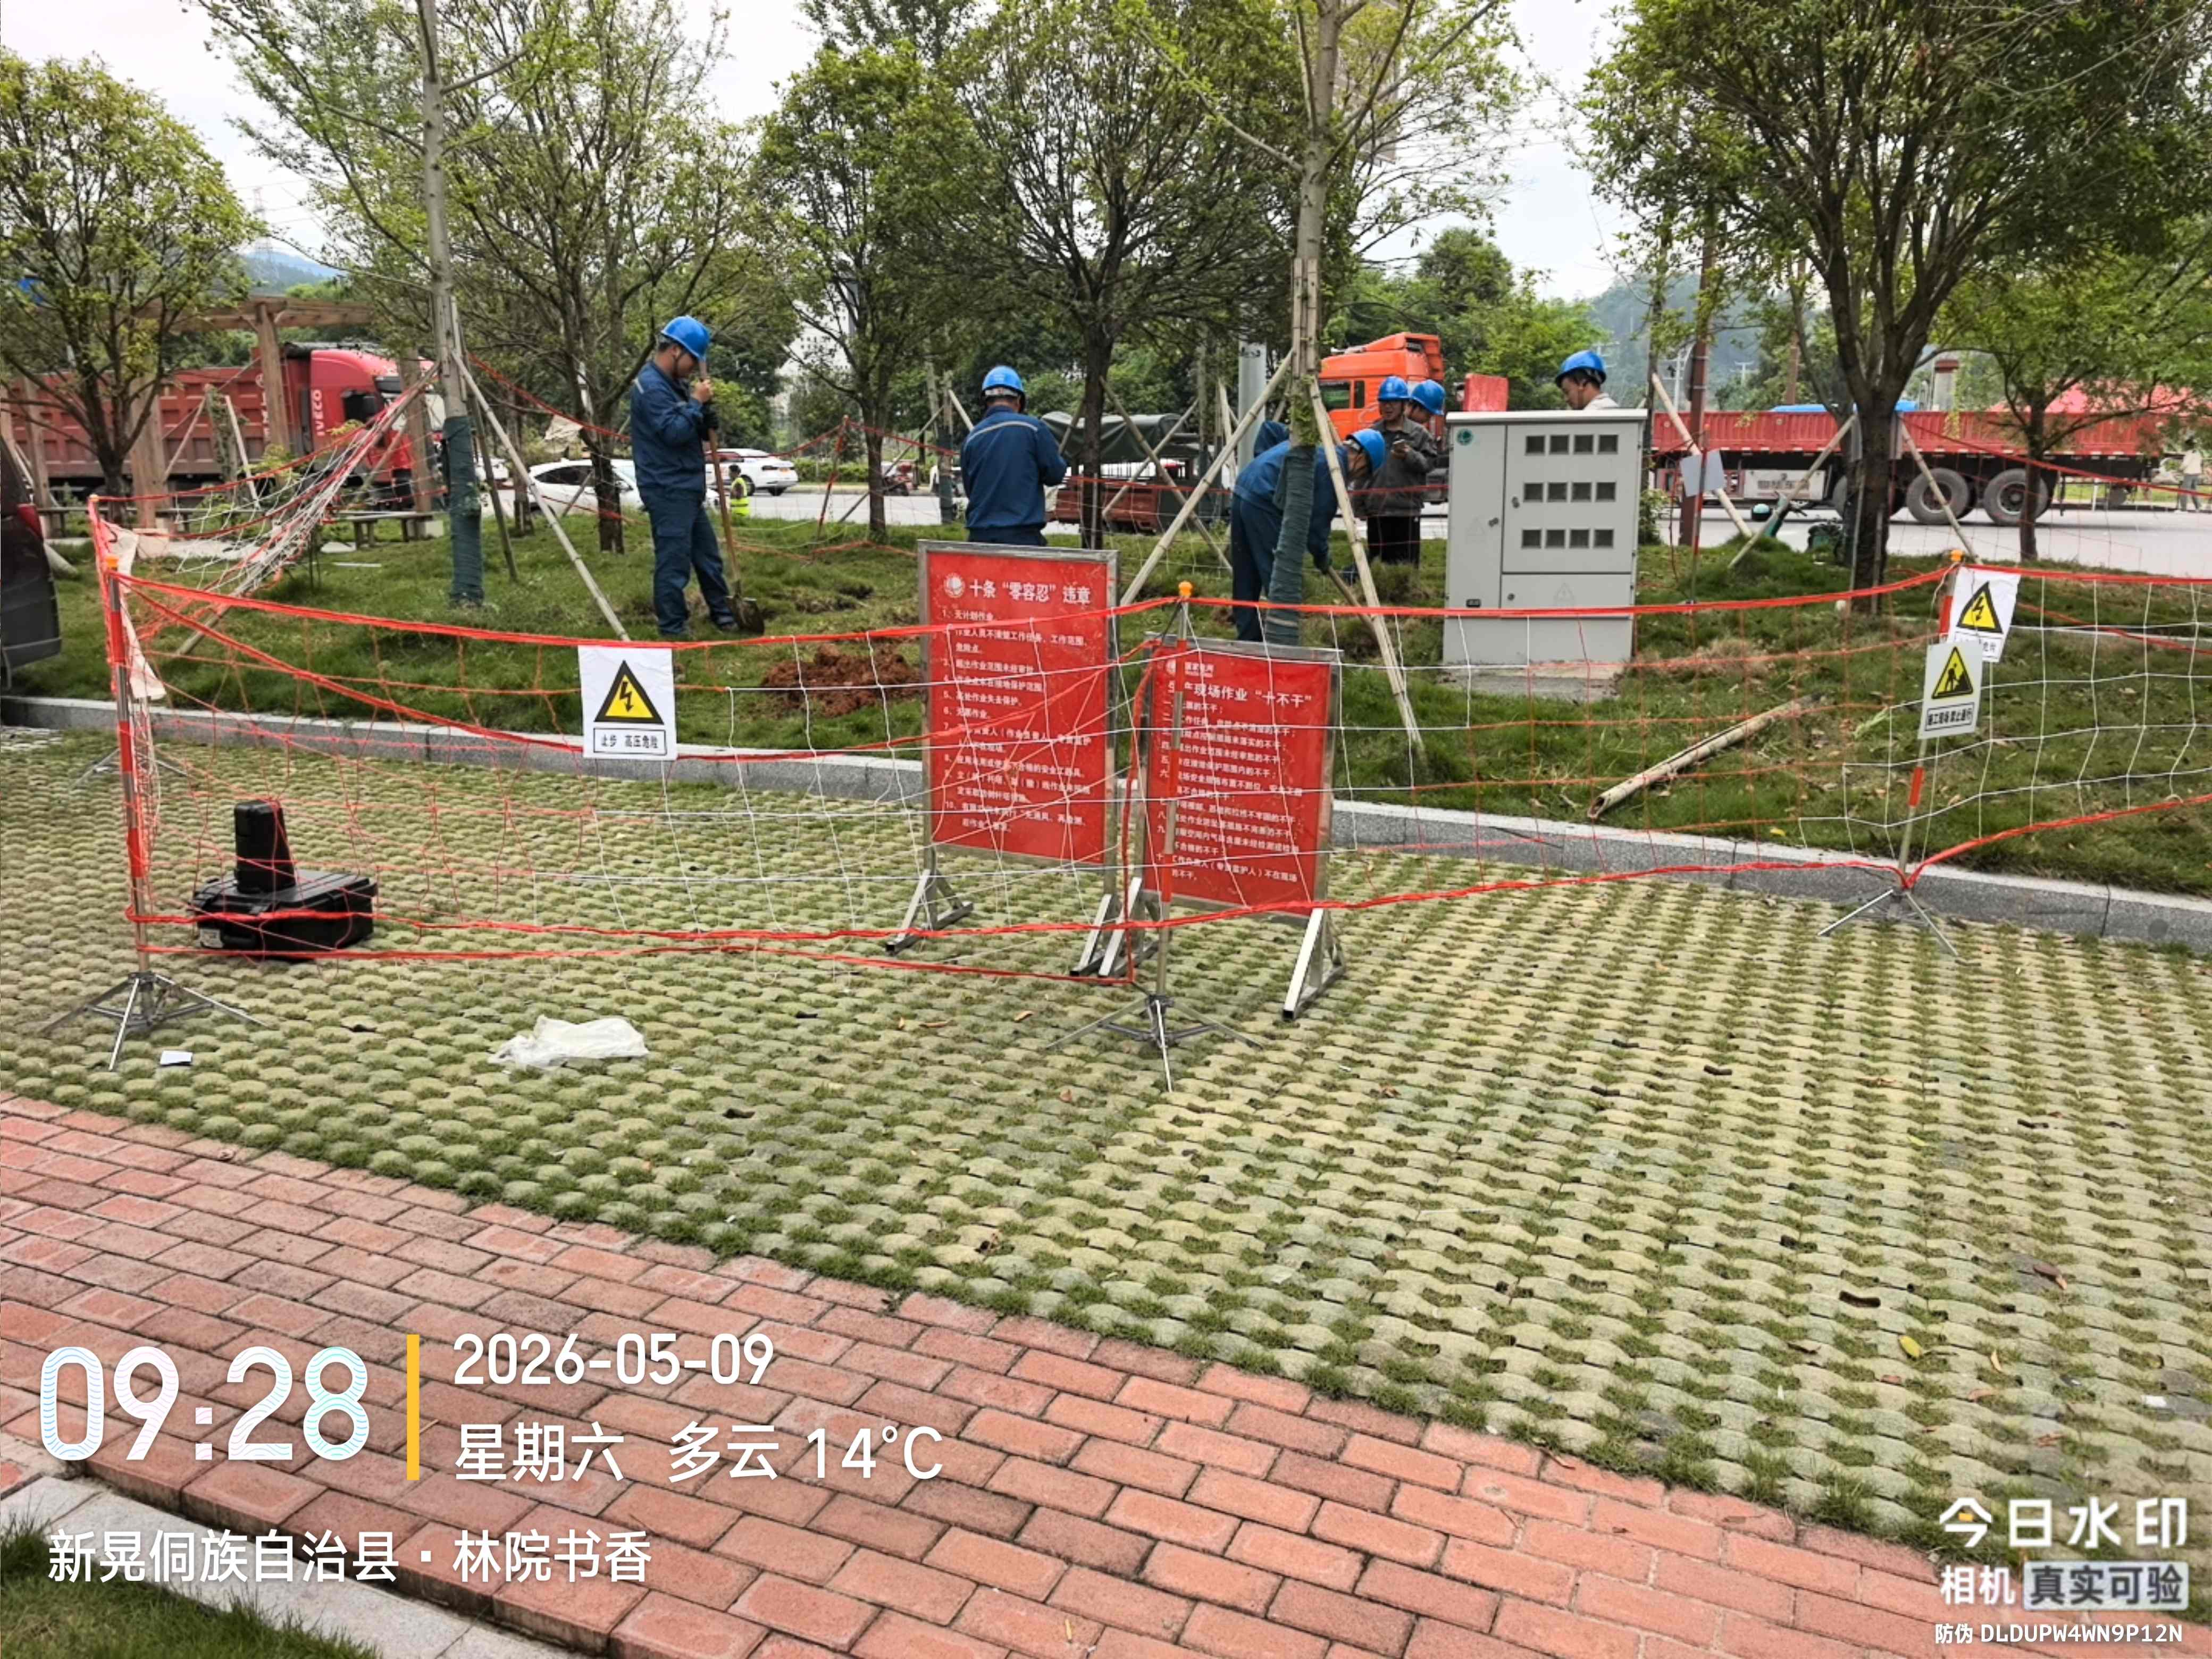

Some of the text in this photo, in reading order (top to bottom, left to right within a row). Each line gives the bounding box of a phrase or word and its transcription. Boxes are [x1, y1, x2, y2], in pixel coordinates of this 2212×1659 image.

[313, 390, 325, 437] IVECO
[601, 734, 659, 749] 止步 高压危险
